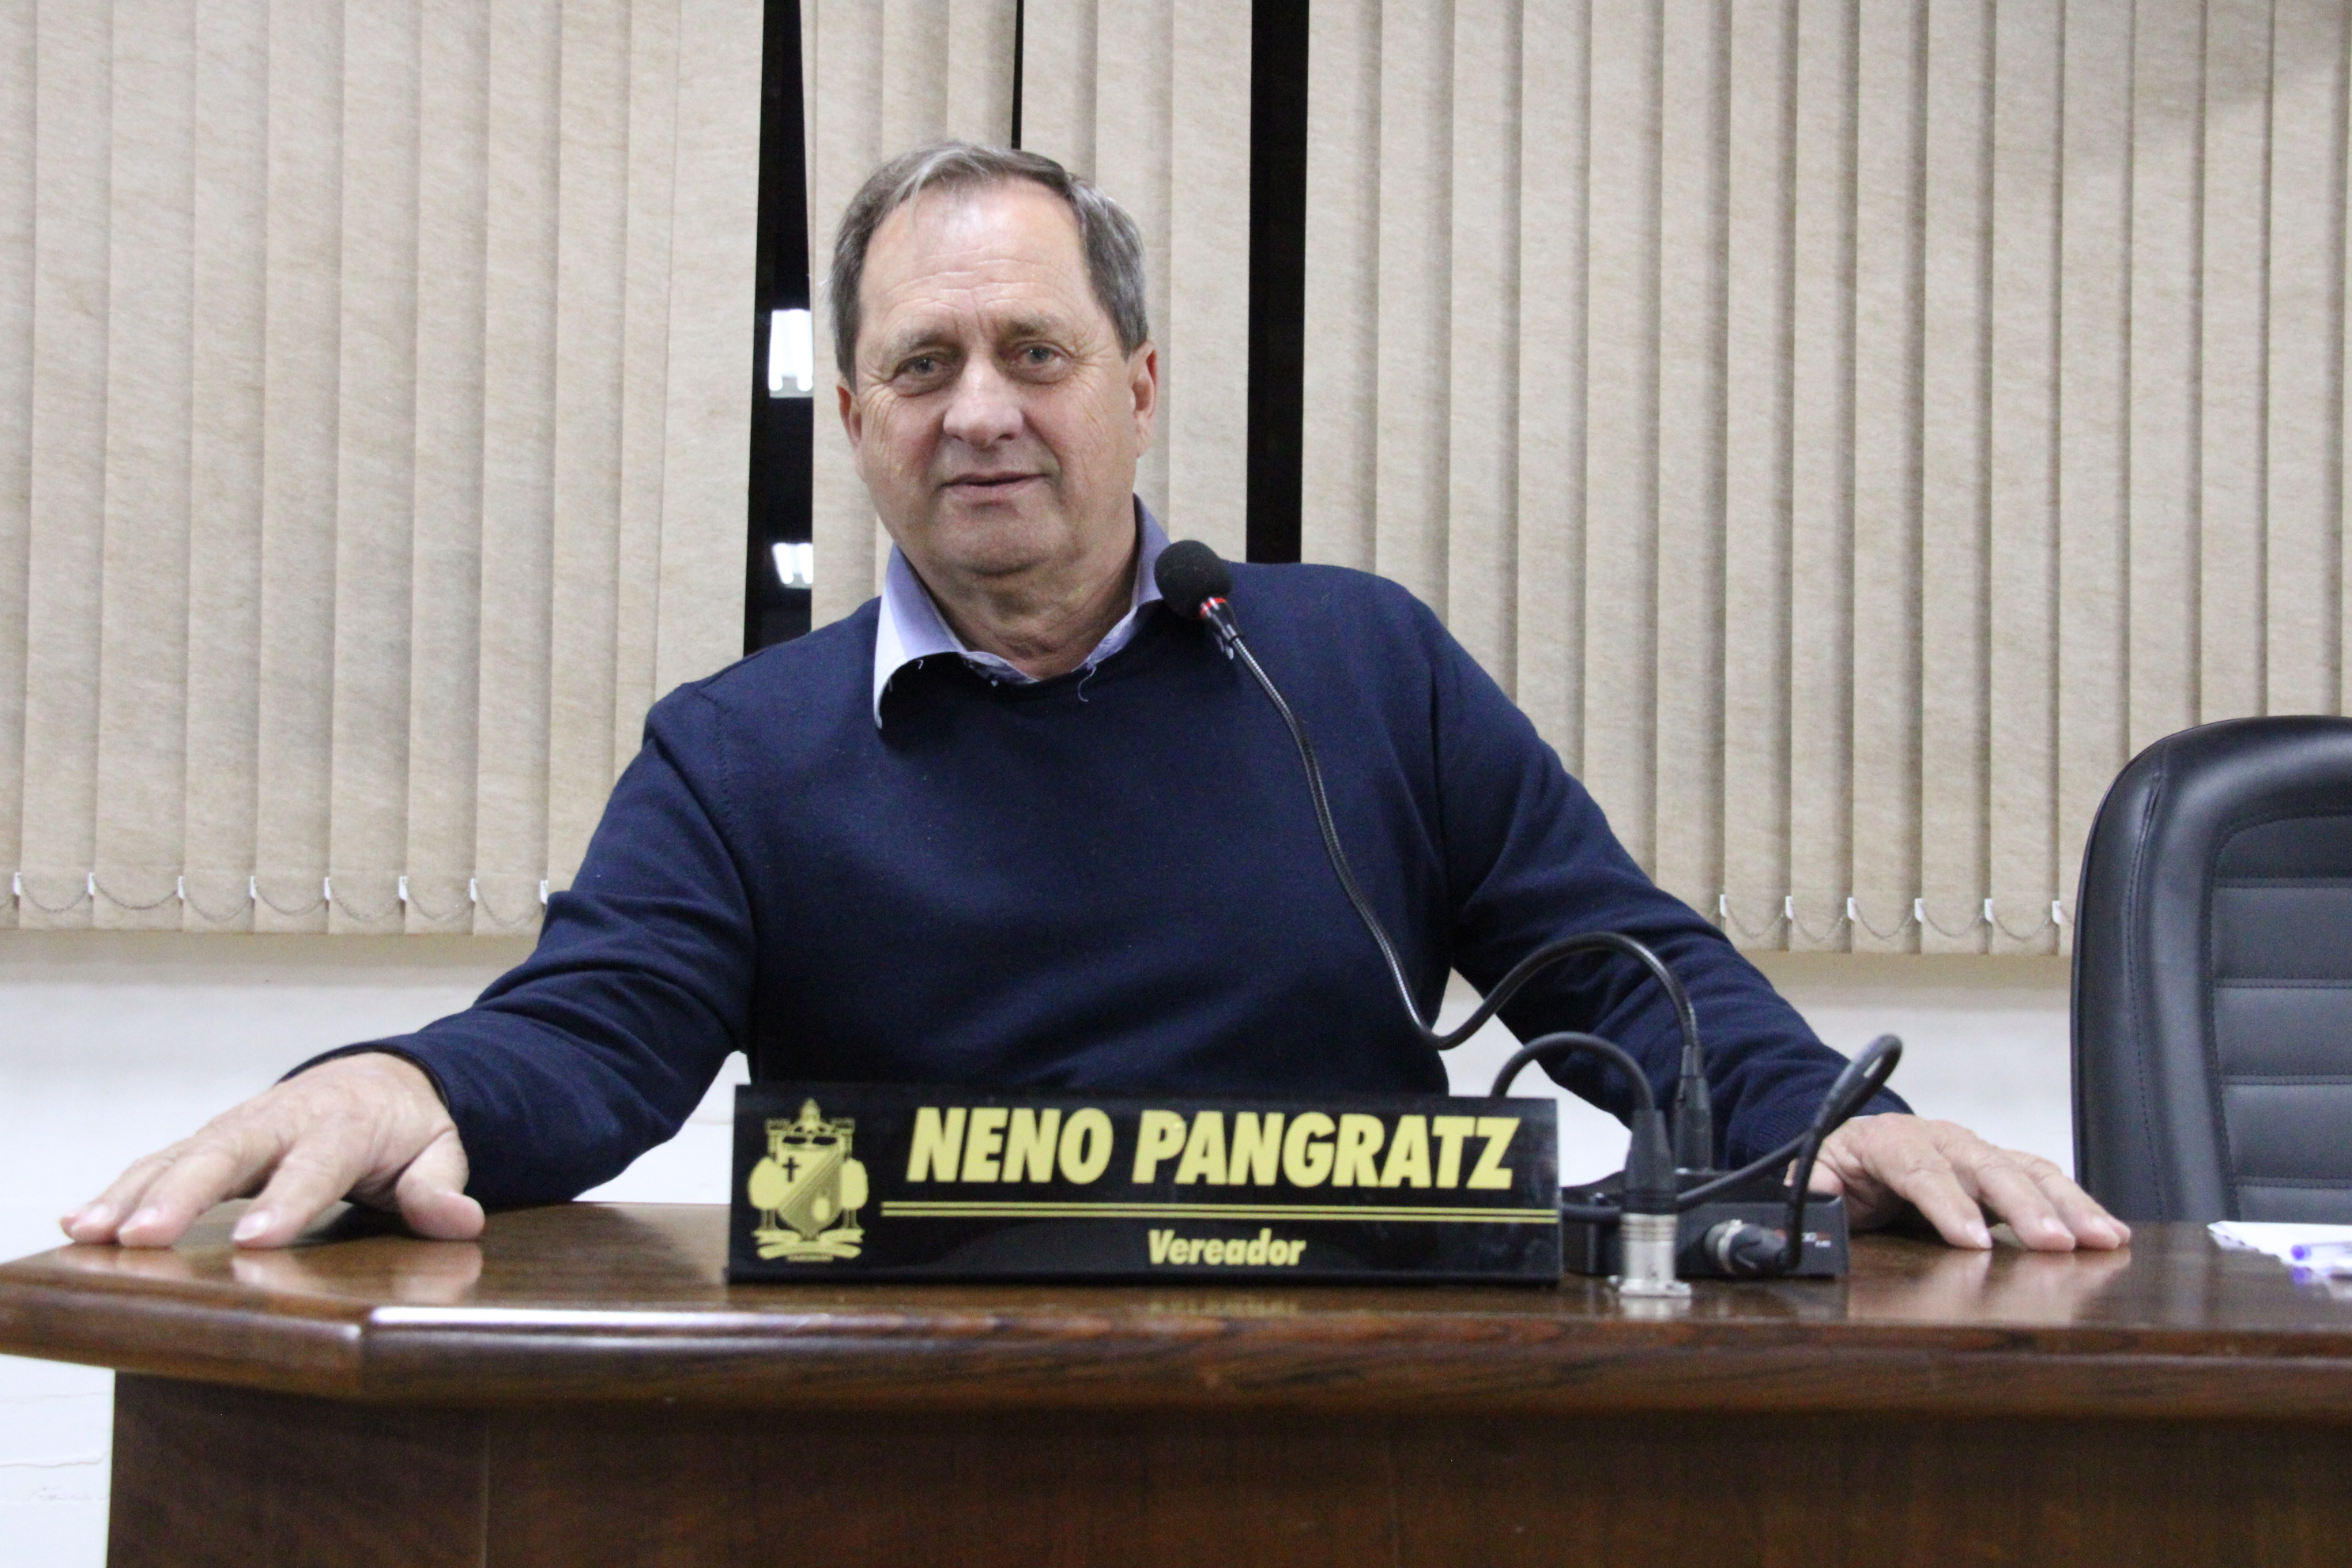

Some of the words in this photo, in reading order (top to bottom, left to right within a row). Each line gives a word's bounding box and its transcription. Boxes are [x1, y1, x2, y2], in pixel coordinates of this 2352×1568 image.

[906, 1106, 1114, 1184] NENO
[1132, 1109, 1521, 1189] PANGRATZ
[1148, 1227, 1306, 1266] Vereador
